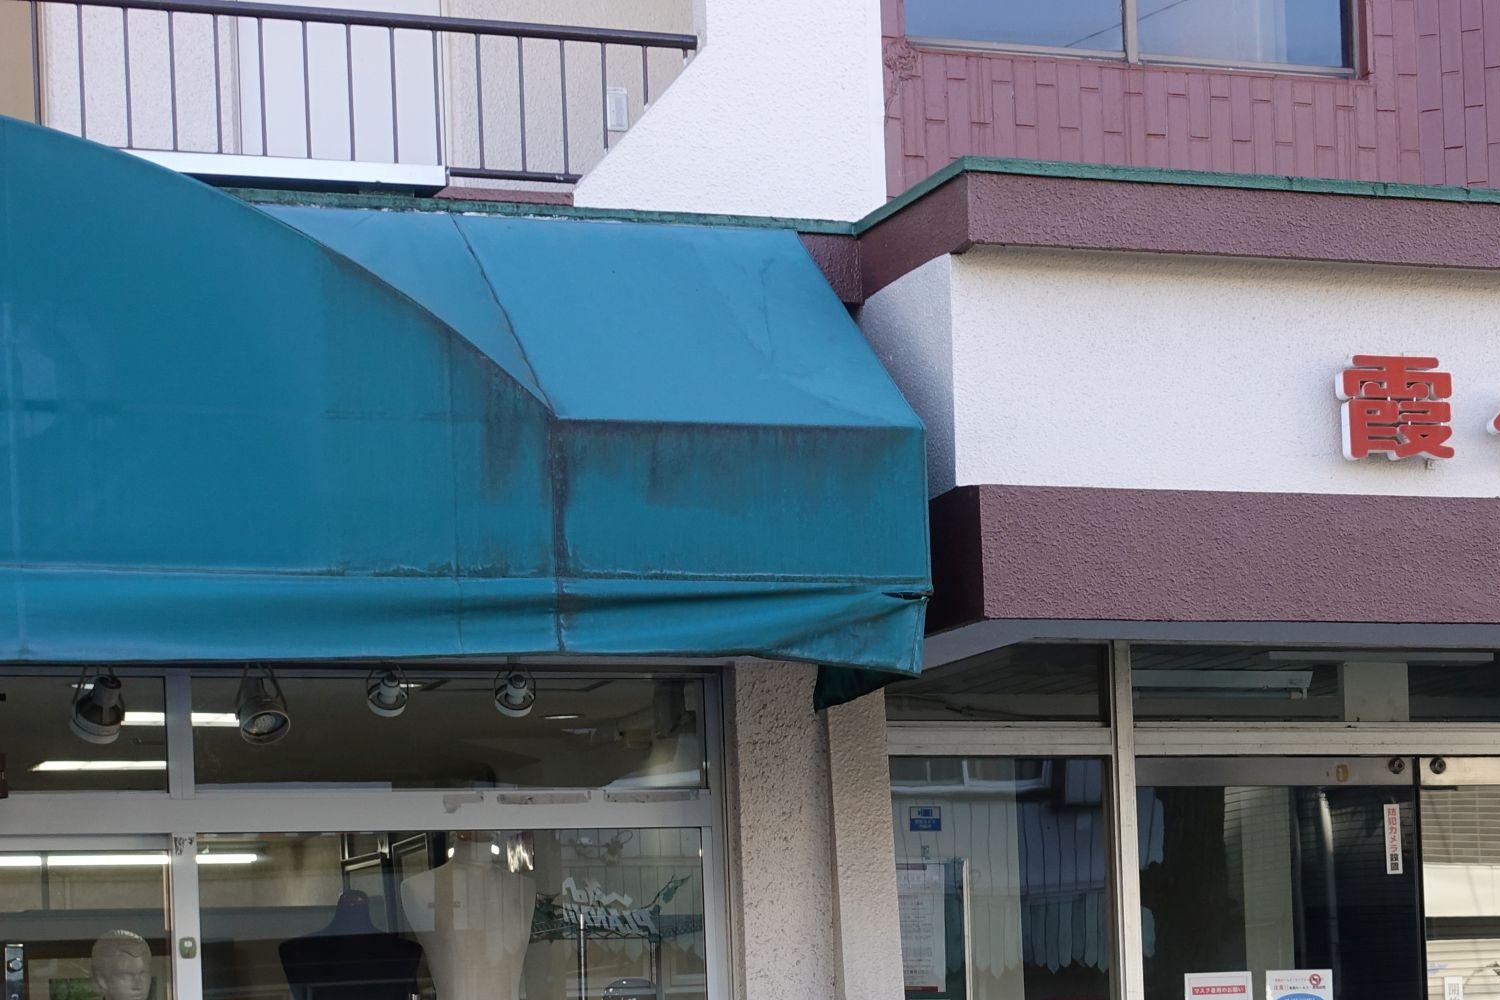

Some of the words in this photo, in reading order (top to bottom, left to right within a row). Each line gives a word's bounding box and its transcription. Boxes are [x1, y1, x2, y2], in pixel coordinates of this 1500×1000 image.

[1387, 807, 1400, 871] 防犯カメラ設置
